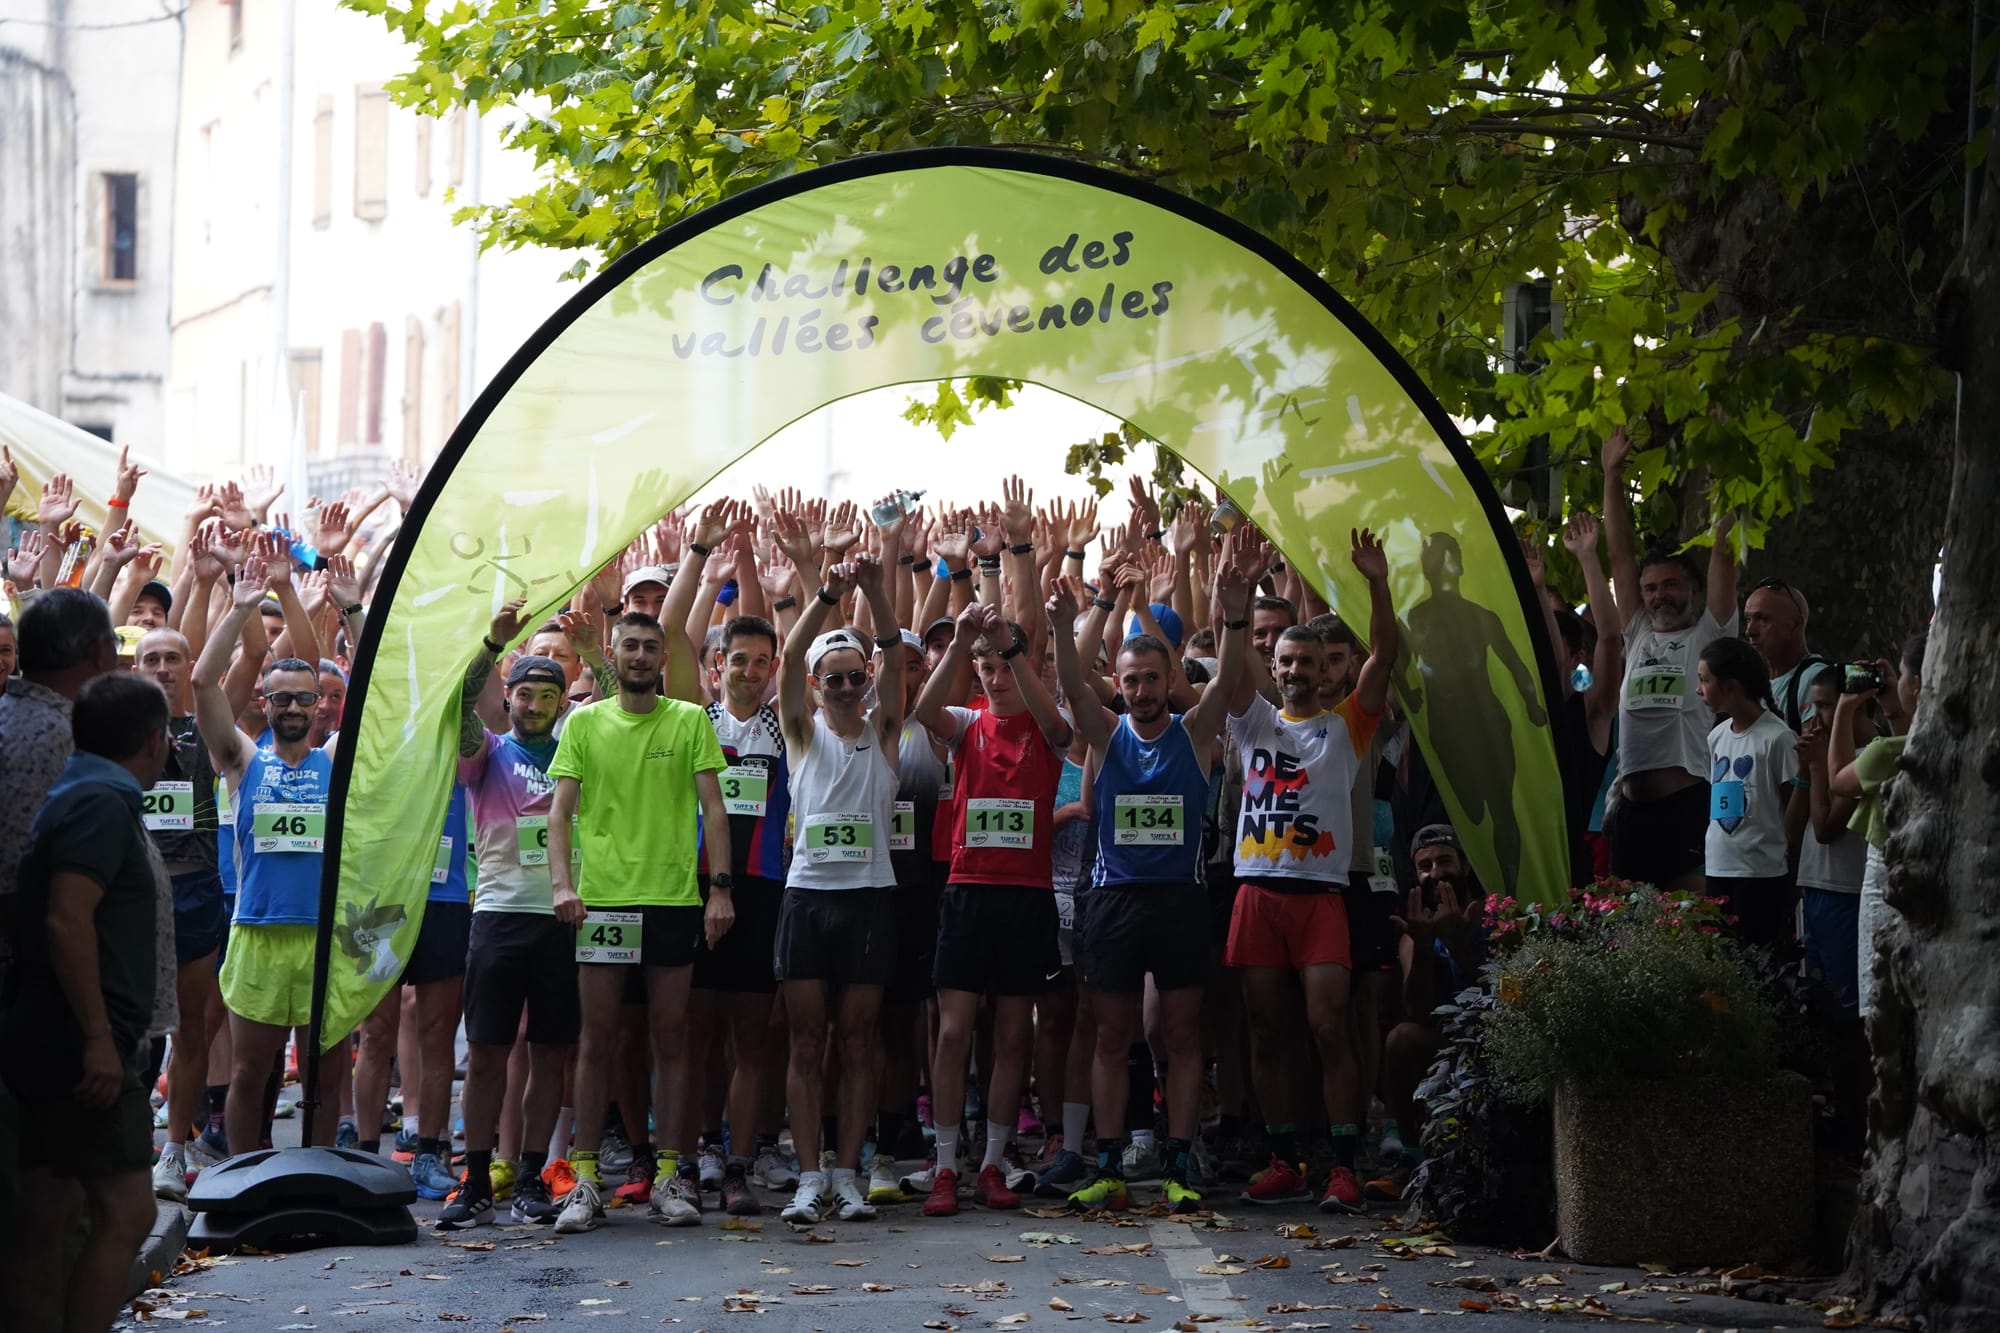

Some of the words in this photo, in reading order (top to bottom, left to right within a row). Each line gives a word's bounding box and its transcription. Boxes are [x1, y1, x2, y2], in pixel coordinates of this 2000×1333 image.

[701, 252, 1000, 305] Challenge
[1039, 231, 1135, 276] des
[671, 310, 880, 360] vallées
[920, 280, 1175, 343] cévenoles
[1636, 676, 1676, 695] 117
[1249, 748, 1301, 780] DE
[725, 779, 741, 798] 3
[1245, 780, 1300, 812] ME
[142, 794, 175, 814] 20
[1719, 795, 1729, 810] 5
[271, 816, 306, 836] 46
[976, 811, 1024, 832] 113
[1125, 807, 1174, 828] 134
[823, 825, 856, 846] 53
[1242, 813, 1320, 847] NTS
[590, 925, 623, 947] 43
